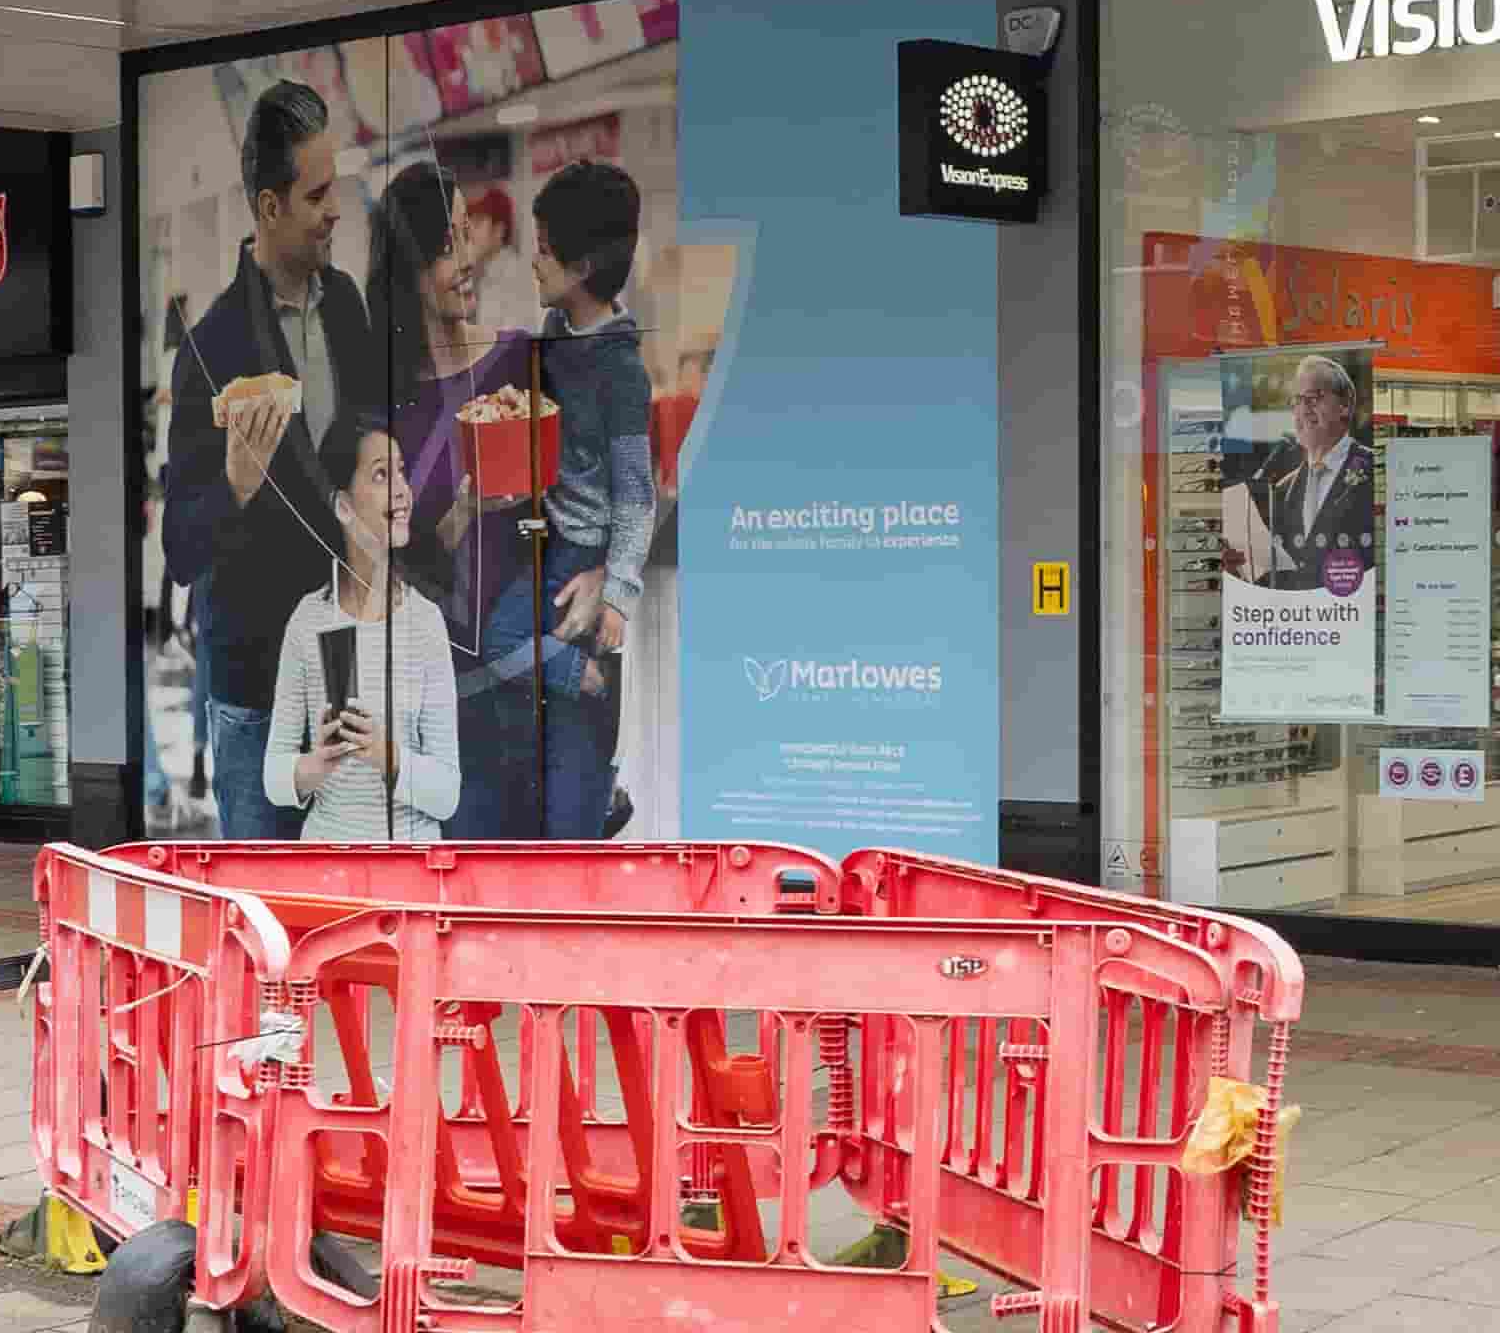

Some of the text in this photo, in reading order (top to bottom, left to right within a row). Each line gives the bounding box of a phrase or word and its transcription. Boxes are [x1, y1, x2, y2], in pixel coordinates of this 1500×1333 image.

[731, 500, 961, 533] An exciting place
[1038, 567, 1064, 609] H
[1232, 602, 1359, 629] Step out with
[1232, 628, 1340, 645] confidence
[791, 658, 942, 693] Marlowes
